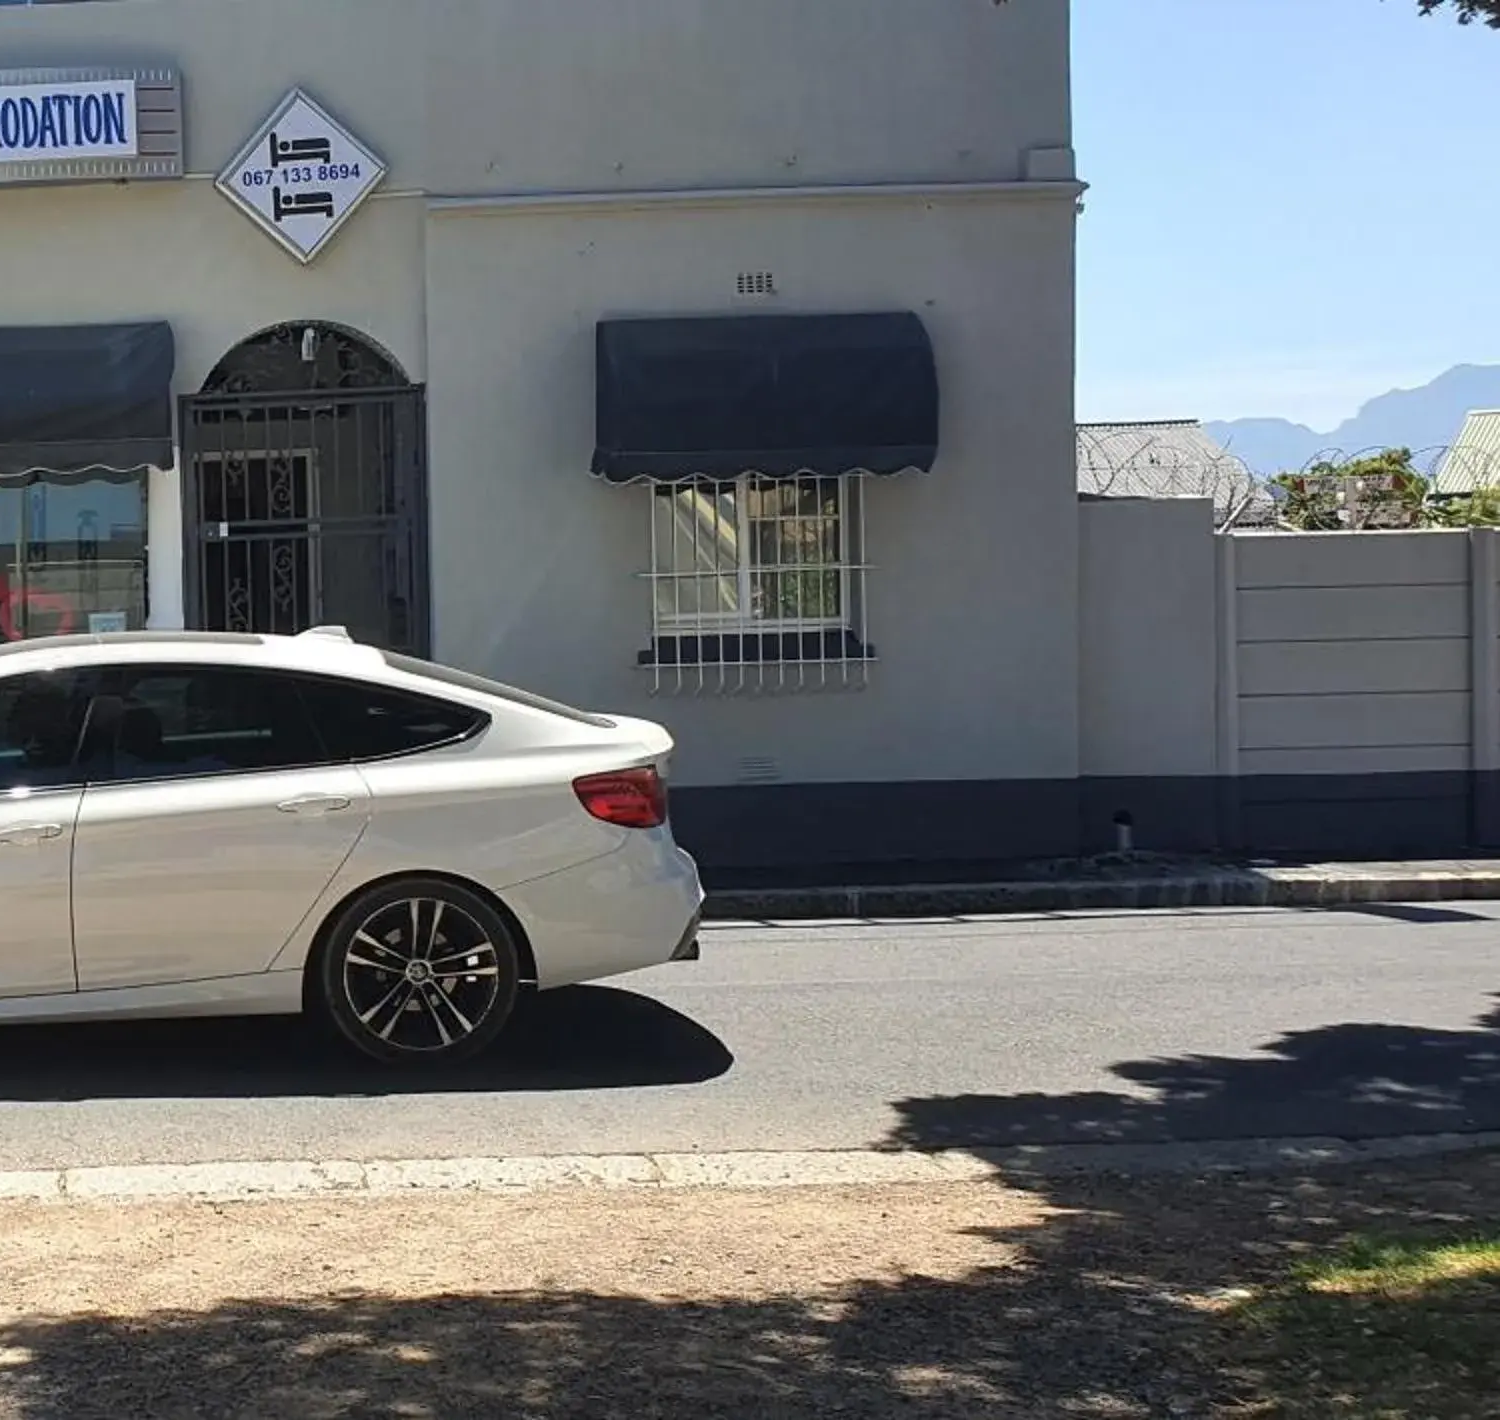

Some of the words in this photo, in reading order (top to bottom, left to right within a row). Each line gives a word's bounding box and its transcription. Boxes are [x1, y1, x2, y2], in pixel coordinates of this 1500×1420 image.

[243, 169, 274, 187] 067
[282, 167, 312, 184] 133
[318, 162, 360, 181] 8694
